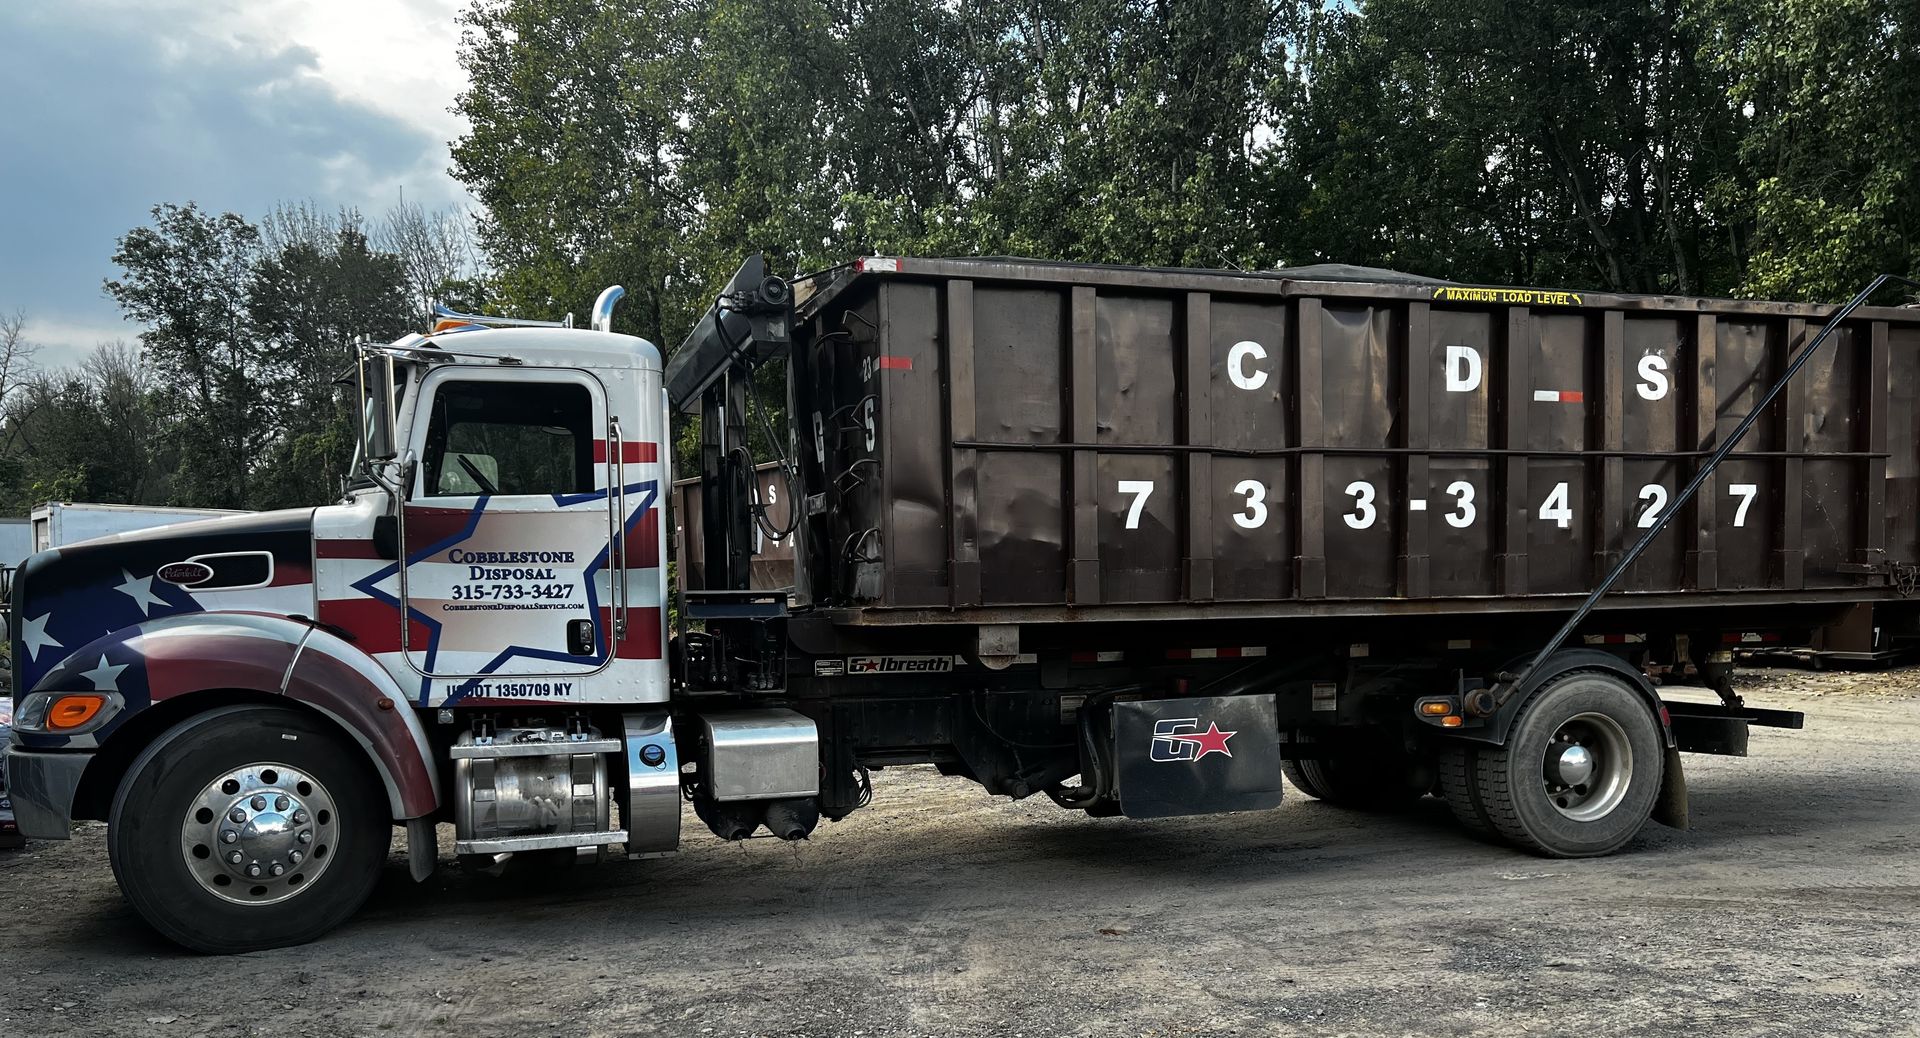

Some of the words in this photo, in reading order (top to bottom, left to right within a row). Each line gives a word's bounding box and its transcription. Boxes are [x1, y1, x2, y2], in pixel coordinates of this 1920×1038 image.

[1446, 290, 1497, 302] MAXIMUM
[1503, 292, 1532, 303] LOAD
[1537, 294, 1570, 305] LEVEL
[862, 355, 872, 383] 23
[448, 549, 575, 564] COBBLESTONE
[164, 567, 205, 579] Peterbilt
[468, 565, 556, 581] DISPOSAL
[451, 583, 575, 600] 315-733-3427
[850, 657, 950, 672] Glbreath
[447, 684, 491, 697] UDOT
[495, 684, 550, 697] 1350709
[554, 683, 572, 696] NY
